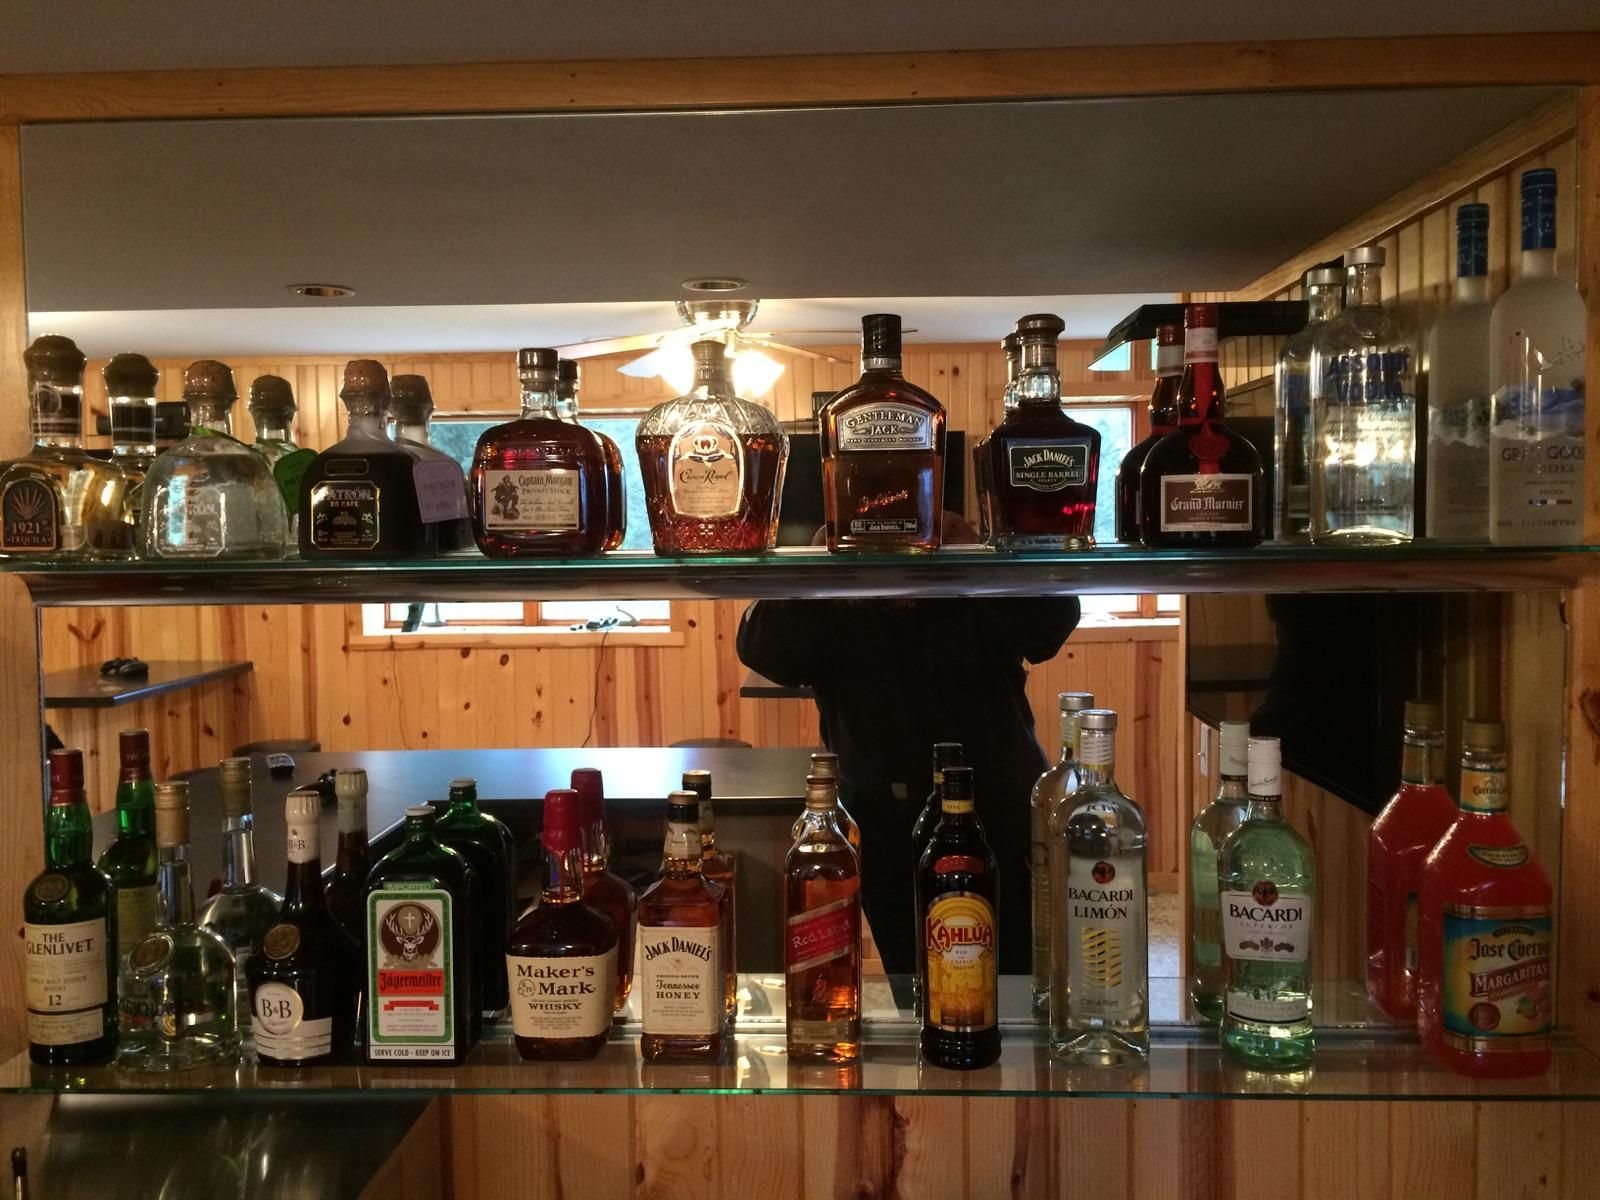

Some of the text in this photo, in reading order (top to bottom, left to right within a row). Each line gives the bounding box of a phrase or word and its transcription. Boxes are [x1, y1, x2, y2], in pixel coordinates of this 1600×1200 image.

[845, 410, 924, 427] GENTLEMAN
[870, 424, 898, 436] JACK
[1023, 449, 1075, 468] JACK DANIEL'S
[518, 473, 573, 488] Captain Morgan
[680, 468, 732, 484] Crown Royal
[1016, 471, 1047, 479] SINGLE
[1170, 496, 1244, 511] Grand Marnier
[13, 522, 40, 534] 1921
[1068, 887, 1133, 902] BACARDI
[1074, 904, 1128, 919] LIMÓN
[1230, 903, 1303, 922] BACARDI
[41, 932, 65, 943] THE
[792, 930, 817, 949] Red
[926, 916, 993, 952] KAHLÚA
[645, 936, 713, 961] JACK DANIEL'S
[1470, 938, 1506, 960] Jose
[516, 964, 595, 979] Maker's
[538, 982, 595, 996] Mark
[656, 980, 700, 990] Tennessee
[48, 994, 62, 1006] 12
[656, 991, 700, 999] HONEY
[262, 998, 292, 1019] B&B
[528, 1002, 583, 1010] WHISKY
